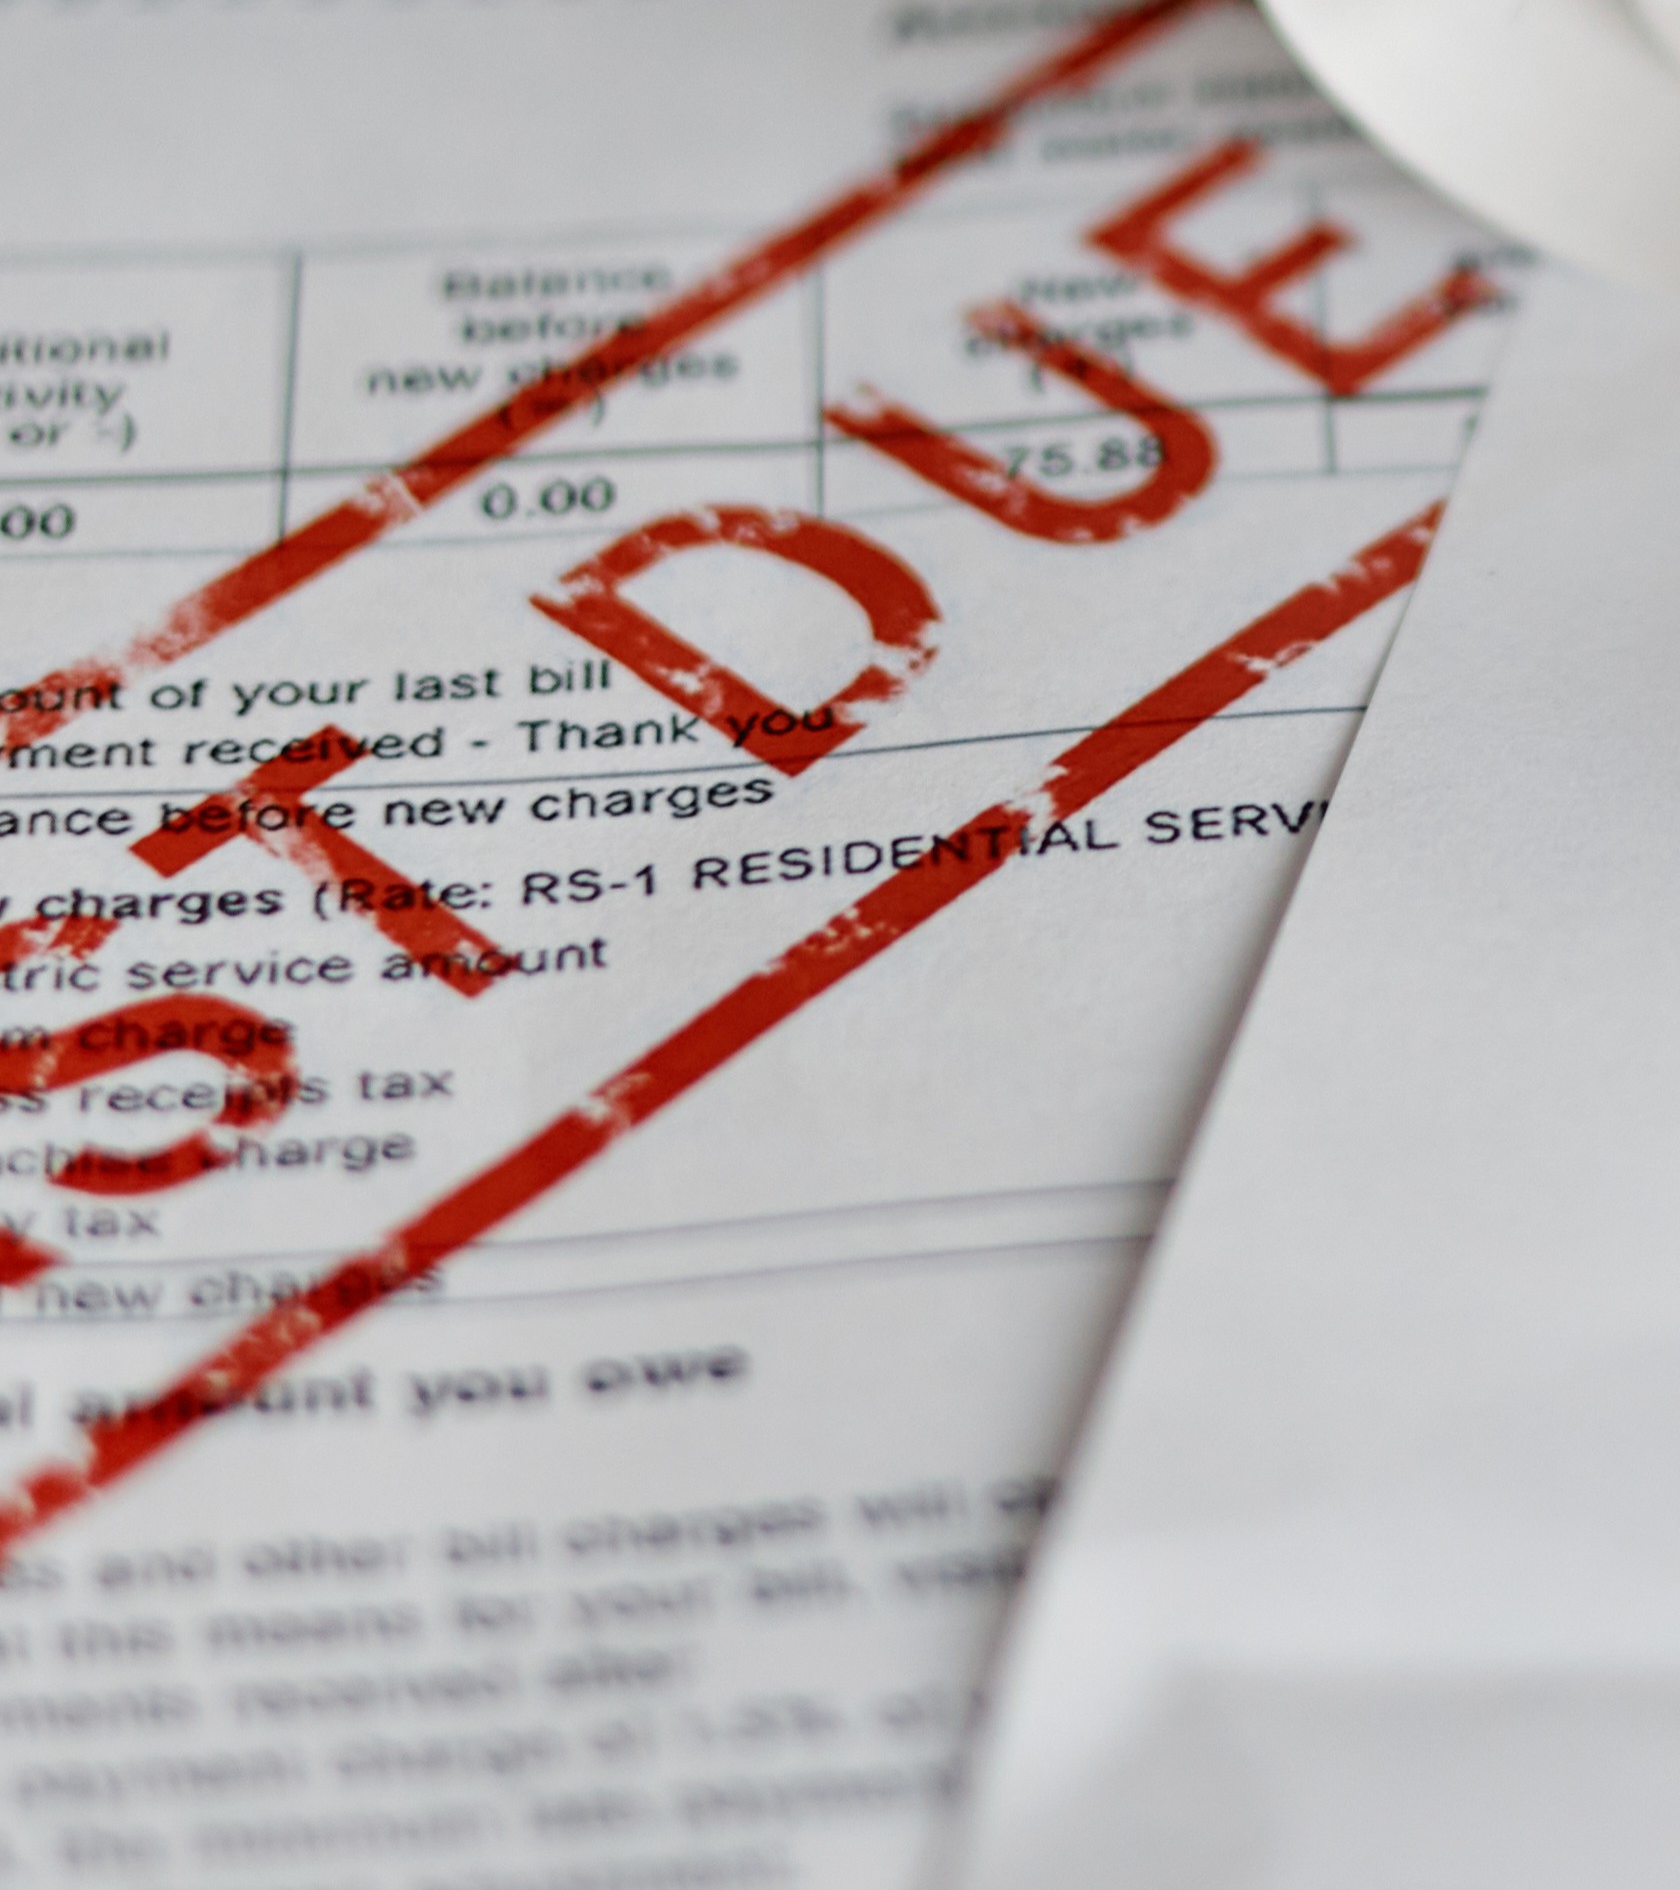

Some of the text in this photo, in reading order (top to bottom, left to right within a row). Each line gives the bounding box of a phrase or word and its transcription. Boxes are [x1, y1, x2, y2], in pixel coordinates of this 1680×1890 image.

[366, 360, 482, 397] new
[530, 138, 1506, 778] DUE
[480, 476, 618, 522] 0.00
[149, 678, 210, 711] of
[232, 678, 370, 714] your
[395, 667, 504, 703] last
[528, 656, 615, 697] bill
[182, 726, 448, 767] received
[518, 710, 702, 755] Thank
[724, 702, 838, 750] you
[160, 794, 357, 835] before
[382, 793, 507, 827] new
[530, 770, 776, 824] charges
[35, 880, 286, 928] charges
[519, 860, 658, 910] RS-1
[691, 814, 1122, 893] RESIDENTIAL
[126, 948, 355, 991] service
[379, 935, 609, 986] amount
[76, 1010, 299, 1056] charge
[356, 1062, 458, 1104] tax
[197, 1126, 420, 1174] charge
[63, 1200, 164, 1243] tax
[33, 1273, 165, 1315] new
[405, 1358, 549, 1420] you
[583, 1340, 754, 1398] owe
